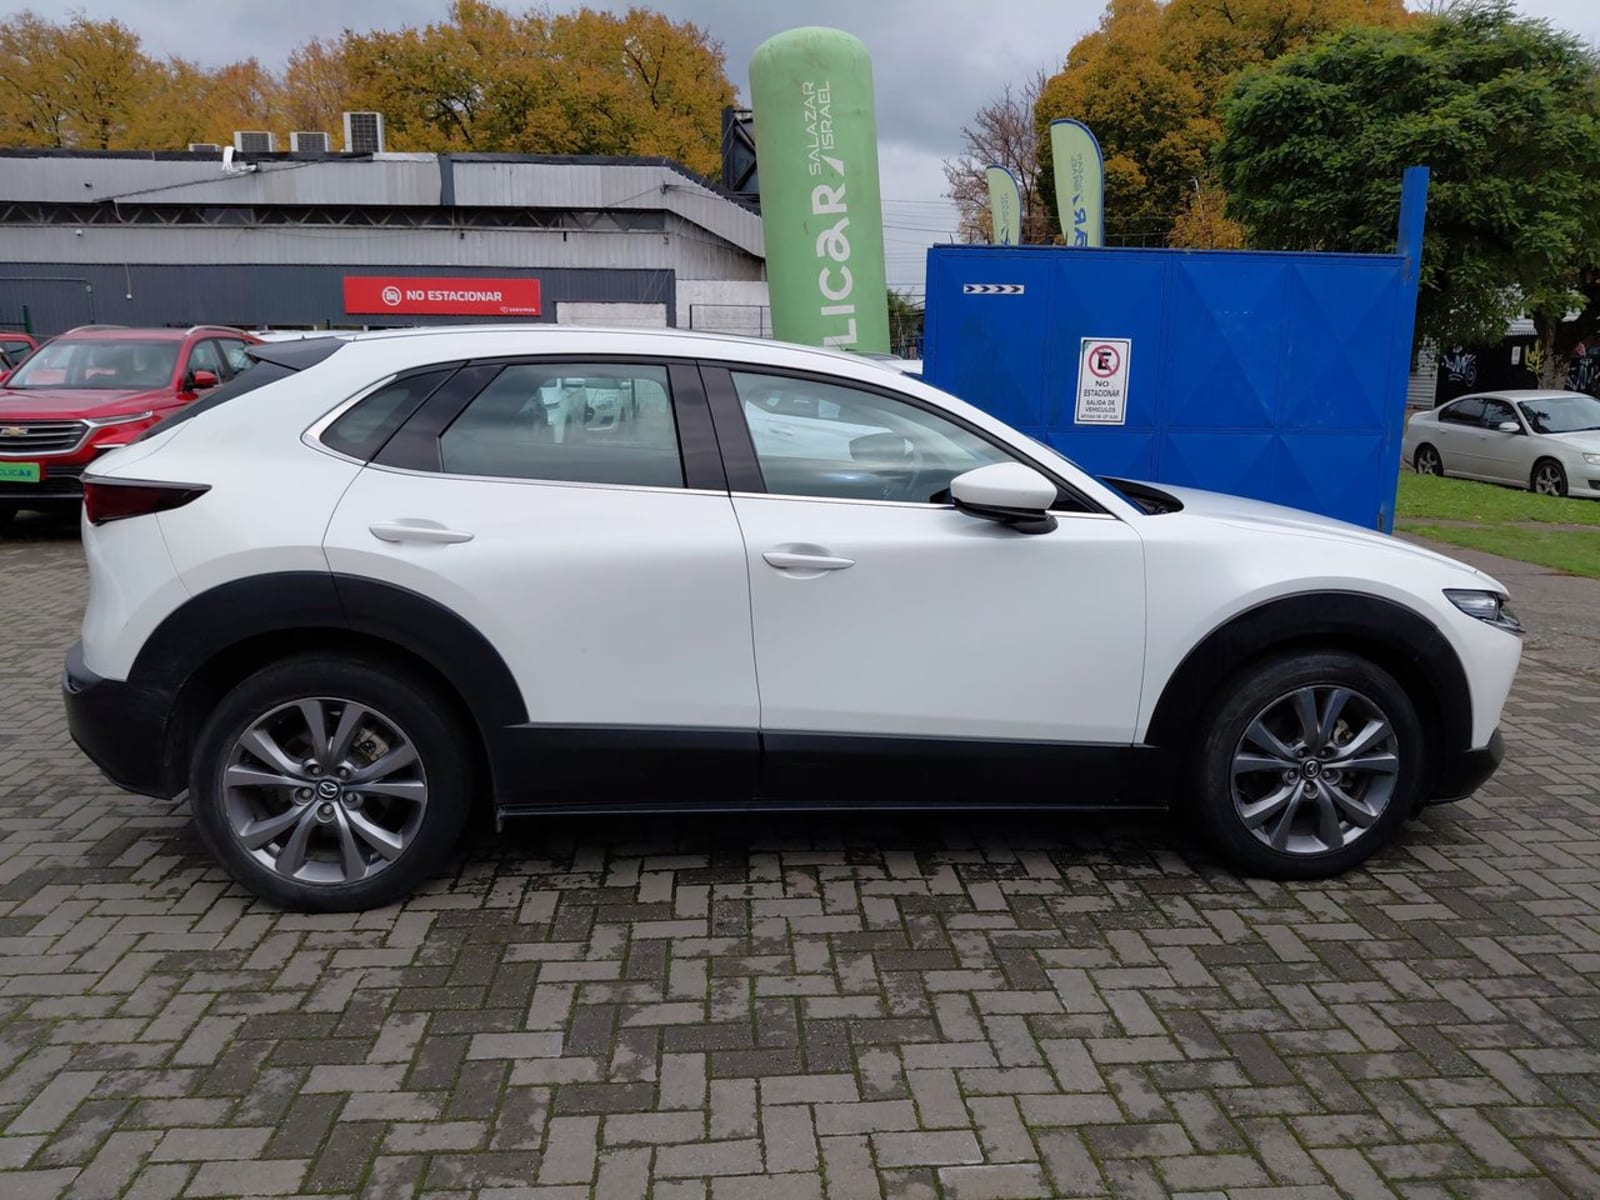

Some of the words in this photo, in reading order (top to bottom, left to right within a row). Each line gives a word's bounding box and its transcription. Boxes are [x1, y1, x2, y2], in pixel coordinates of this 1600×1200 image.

[803, 81, 821, 176] SALAZAR
[818, 81, 833, 149] ISRAEL
[406, 290, 425, 301] NO
[427, 290, 503, 302] ESTACIONAR
[1083, 389, 1120, 397] ESTACIONAR
